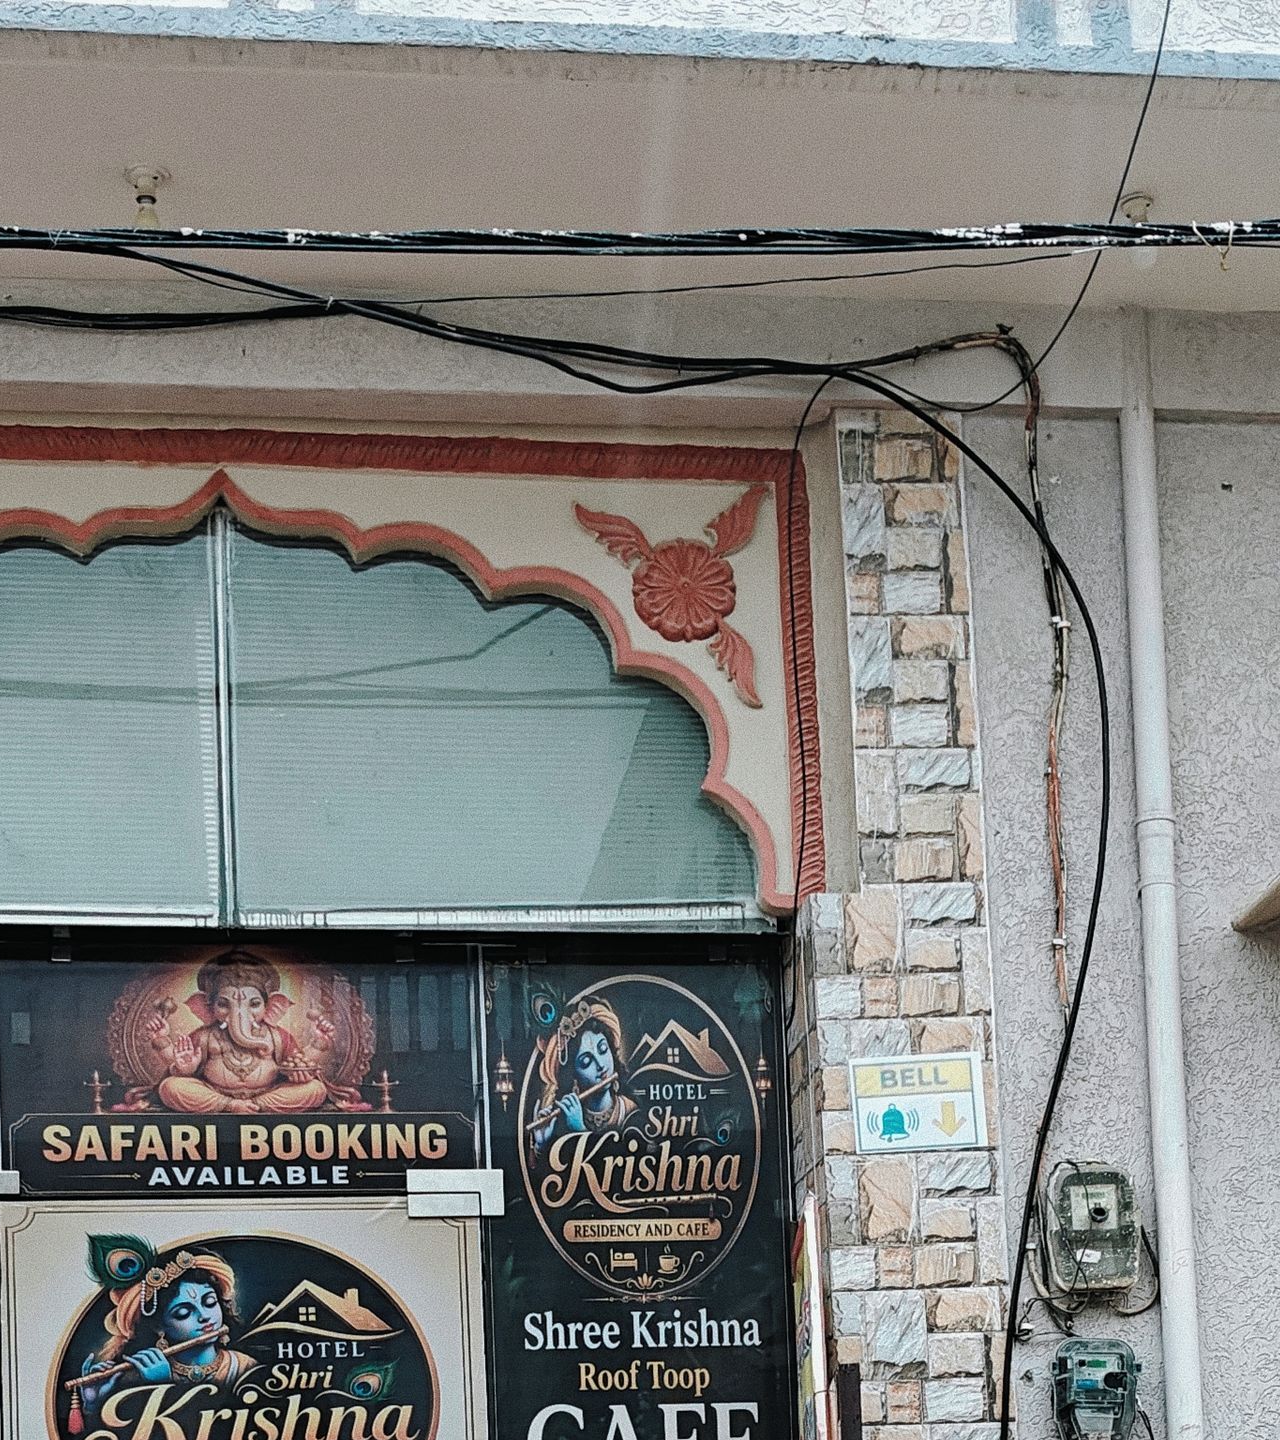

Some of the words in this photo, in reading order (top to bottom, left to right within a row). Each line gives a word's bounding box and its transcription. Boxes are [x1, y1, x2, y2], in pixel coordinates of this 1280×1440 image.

[880, 1065, 948, 1089] BELL
[649, 1084, 707, 1101] HOTEL
[644, 1106, 700, 1138] Shri
[41, 1123, 218, 1162] SAFARI
[241, 1122, 448, 1160] BOOKING
[147, 1164, 350, 1187] AVAILABLE
[540, 1131, 742, 1213] Krishna
[573, 1223, 642, 1238] RESIDENCY
[645, 1223, 673, 1237] AND
[677, 1222, 710, 1236] CAFE
[523, 1310, 621, 1352] Shree
[630, 1308, 762, 1350] Krishna
[278, 1341, 366, 1359] HOTEL
[266, 1363, 334, 1392] Shri
[577, 1360, 640, 1391] Roof
[646, 1361, 711, 1397] Toop
